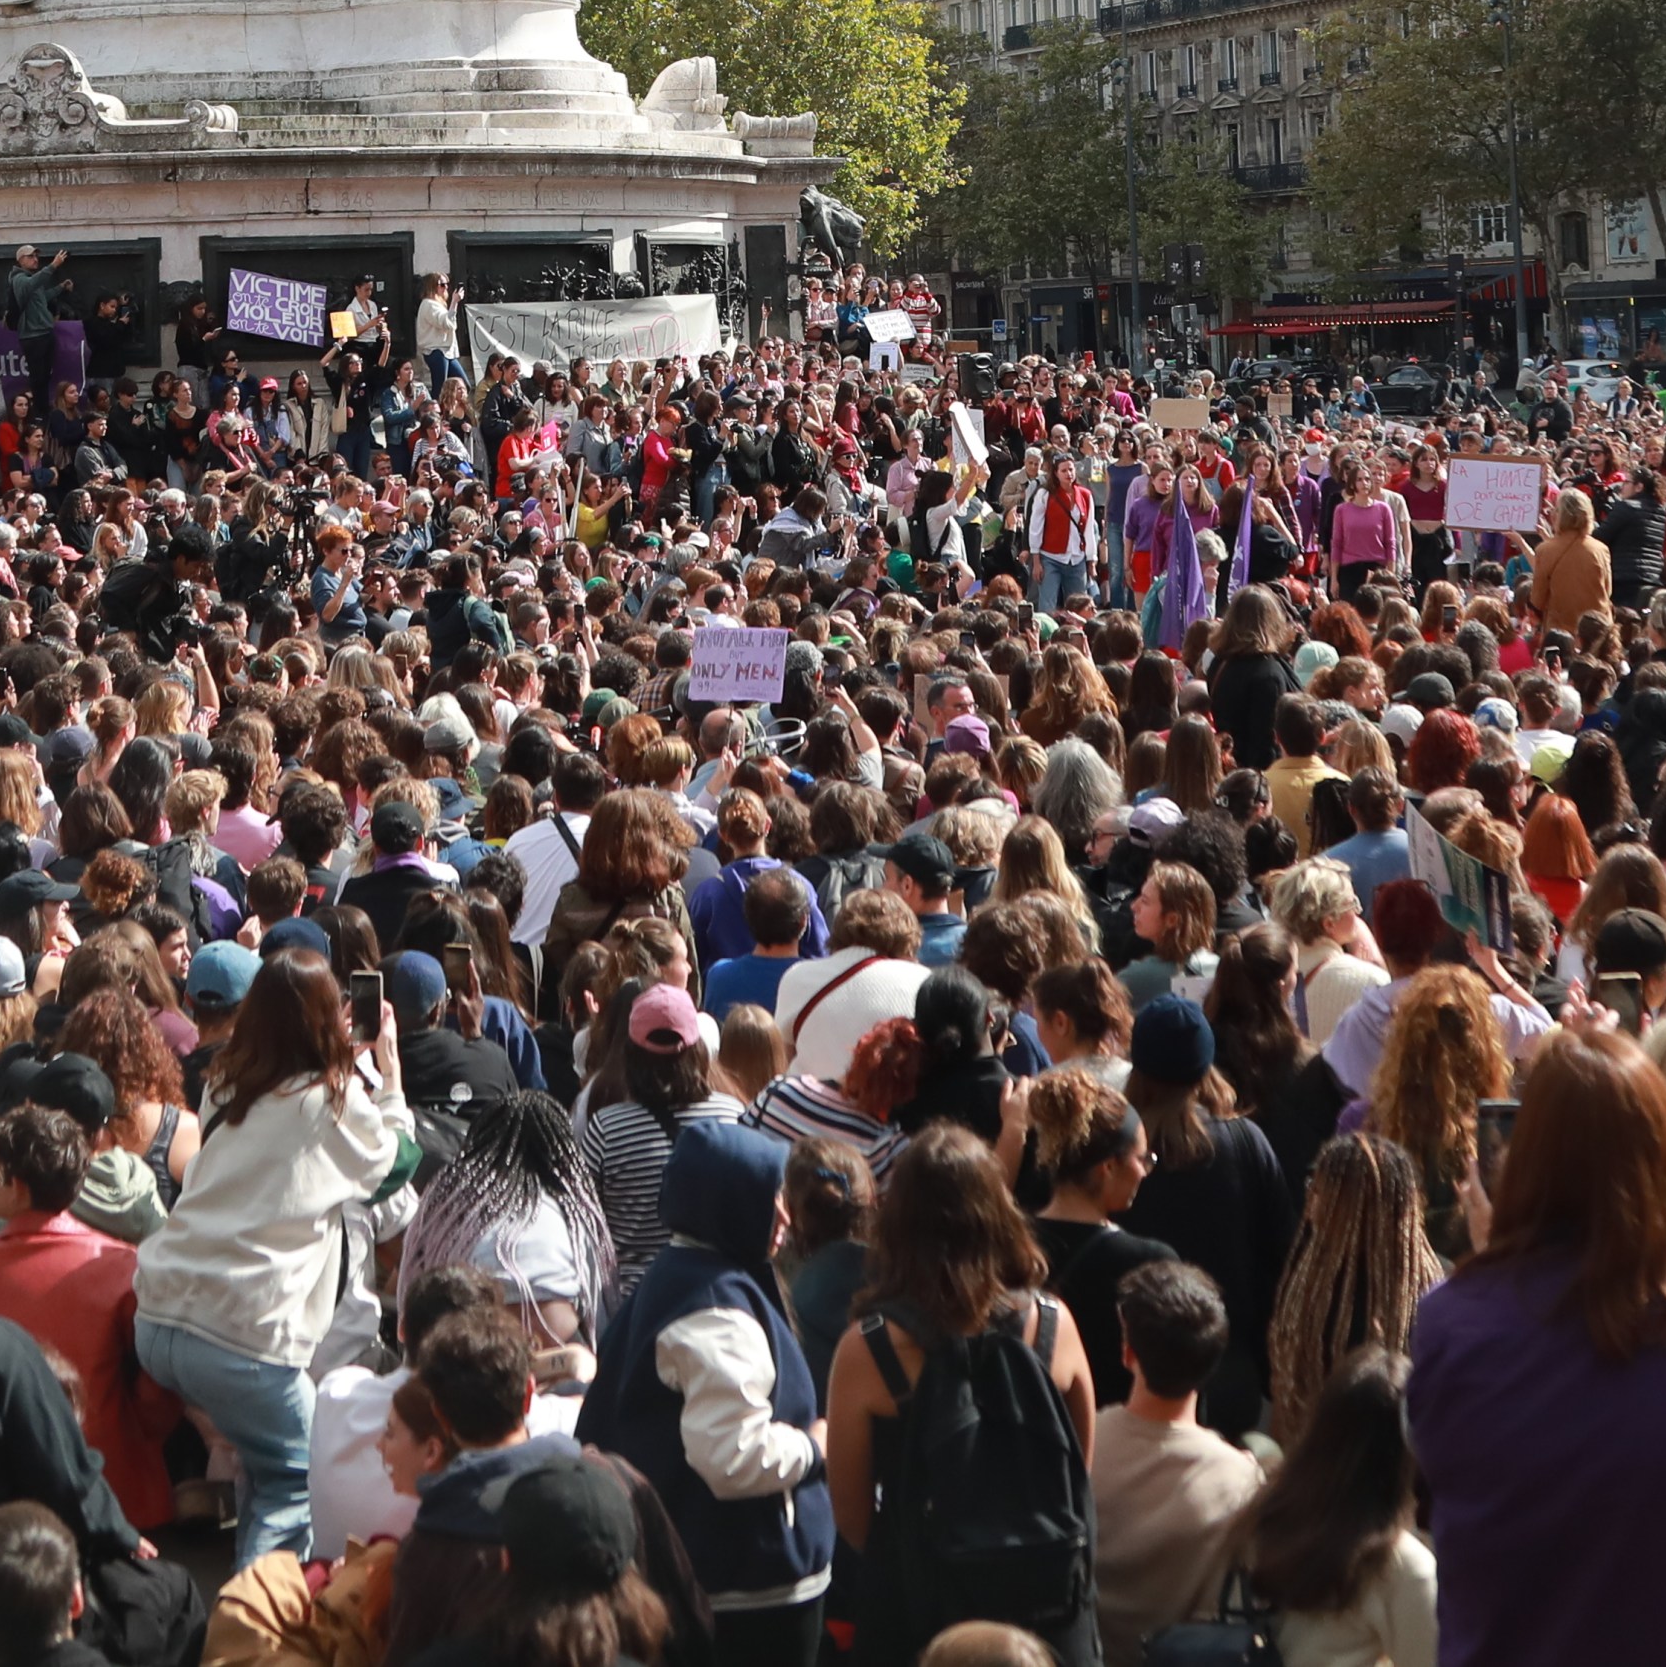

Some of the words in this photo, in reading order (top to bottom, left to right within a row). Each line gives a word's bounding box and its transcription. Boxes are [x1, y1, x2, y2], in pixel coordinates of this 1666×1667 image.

[261, 192, 322, 210] MARS
[334, 192, 375, 208] 1848
[230, 271, 327, 306] VICTIME
[229, 299, 324, 333] VIOLEUR
[232, 291, 253, 305] on
[253, 295, 273, 309] te
[275, 297, 326, 319] CROIT
[229, 318, 254, 332] on
[253, 319, 273, 335] te
[273, 322, 324, 346] VOIT
[543, 309, 561, 339] LA
[1452, 462, 1469, 478] LA
[1486, 467, 1536, 490] HONTE
[1454, 502, 1483, 522] DE
[1493, 503, 1535, 523] CAMP
[691, 661, 731, 679] ONLY
